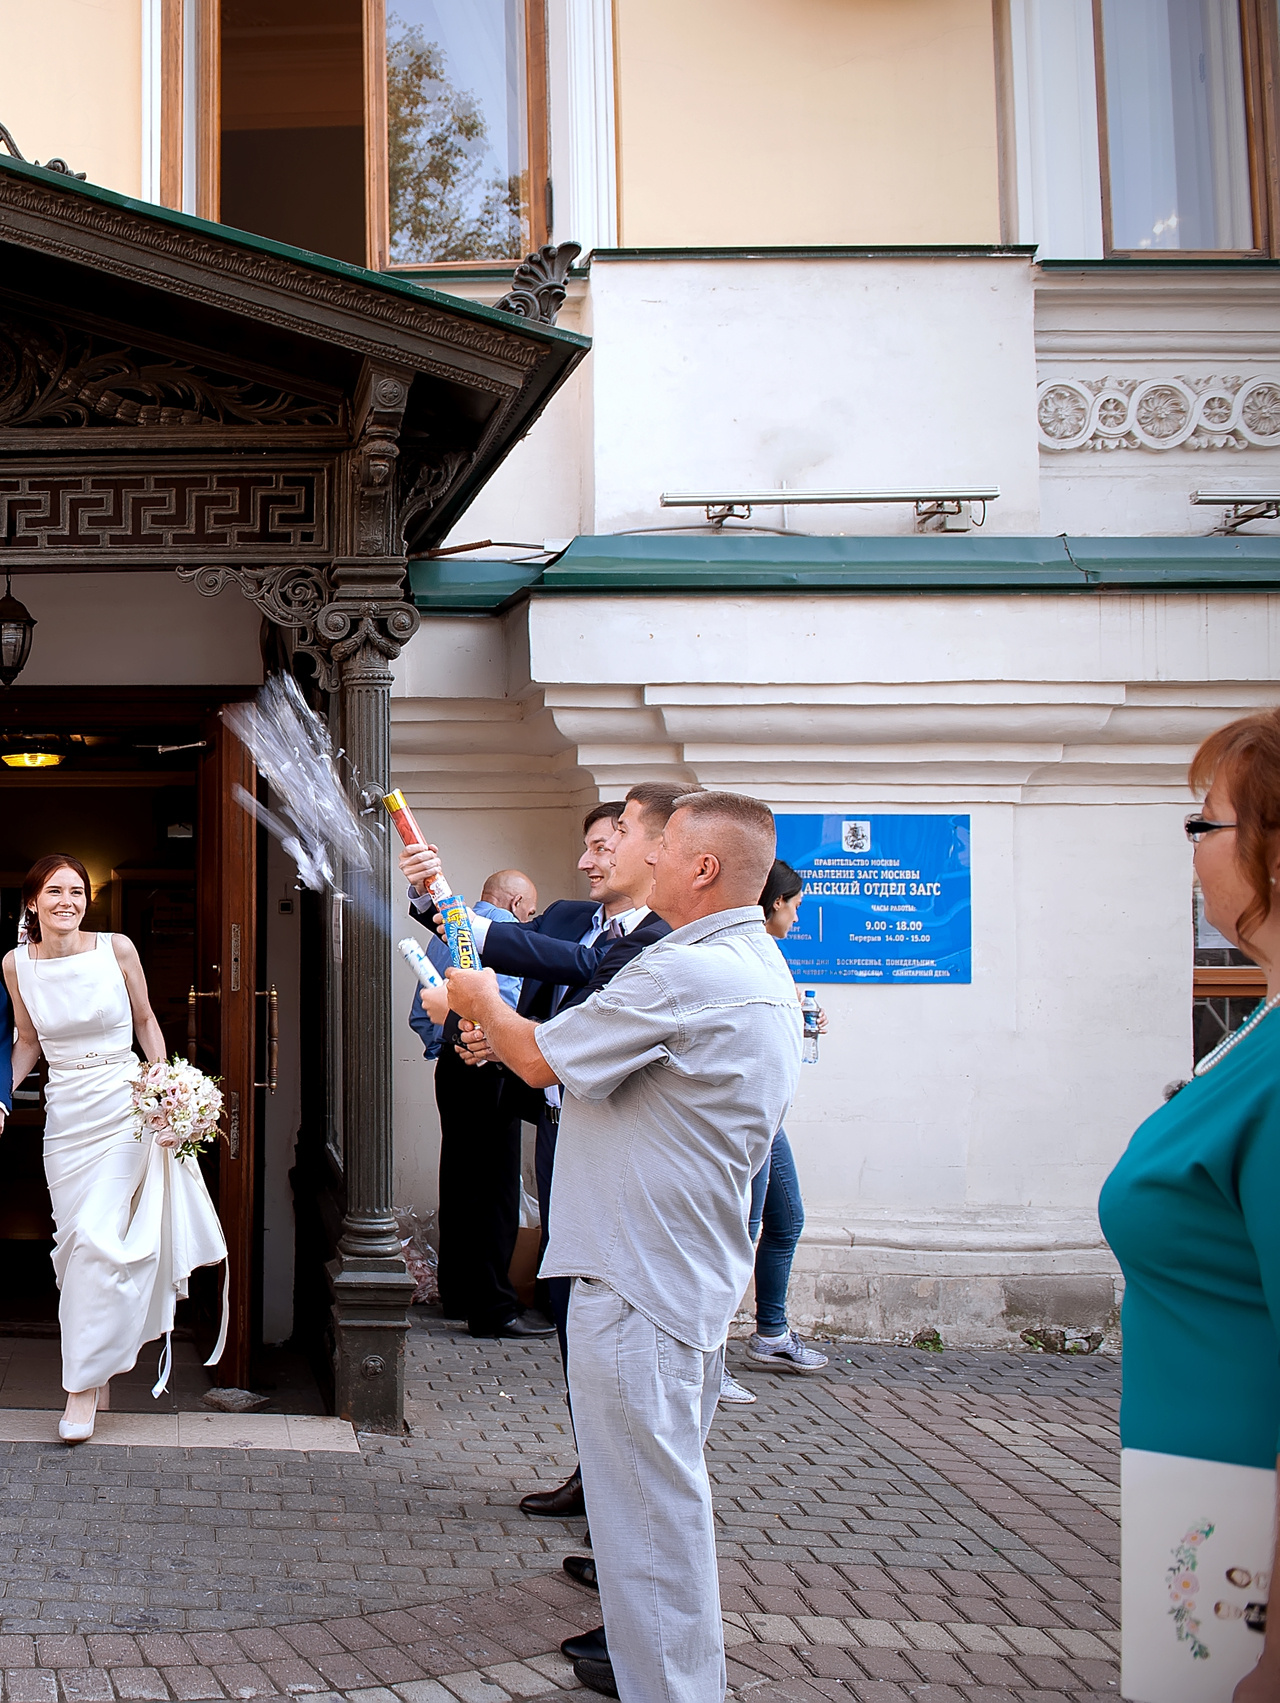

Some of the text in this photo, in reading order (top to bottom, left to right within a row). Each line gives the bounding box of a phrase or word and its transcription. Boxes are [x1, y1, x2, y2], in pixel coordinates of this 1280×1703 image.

[871, 859, 900, 867] МОСКВЫ
[857, 870, 879, 879] ЗАГС
[881, 870, 920, 879] МОСКВЫ
[801, 880, 941, 898] АНСКИЙ ОТДЕЛ ЗАГС
[871, 904, 889, 912] ЧАСЫ
[865, 920, 887, 930] 9.00
[896, 921, 923, 931] 18.00
[849, 934, 881, 943] Перерыв
[885, 934, 905, 942] 14.00
